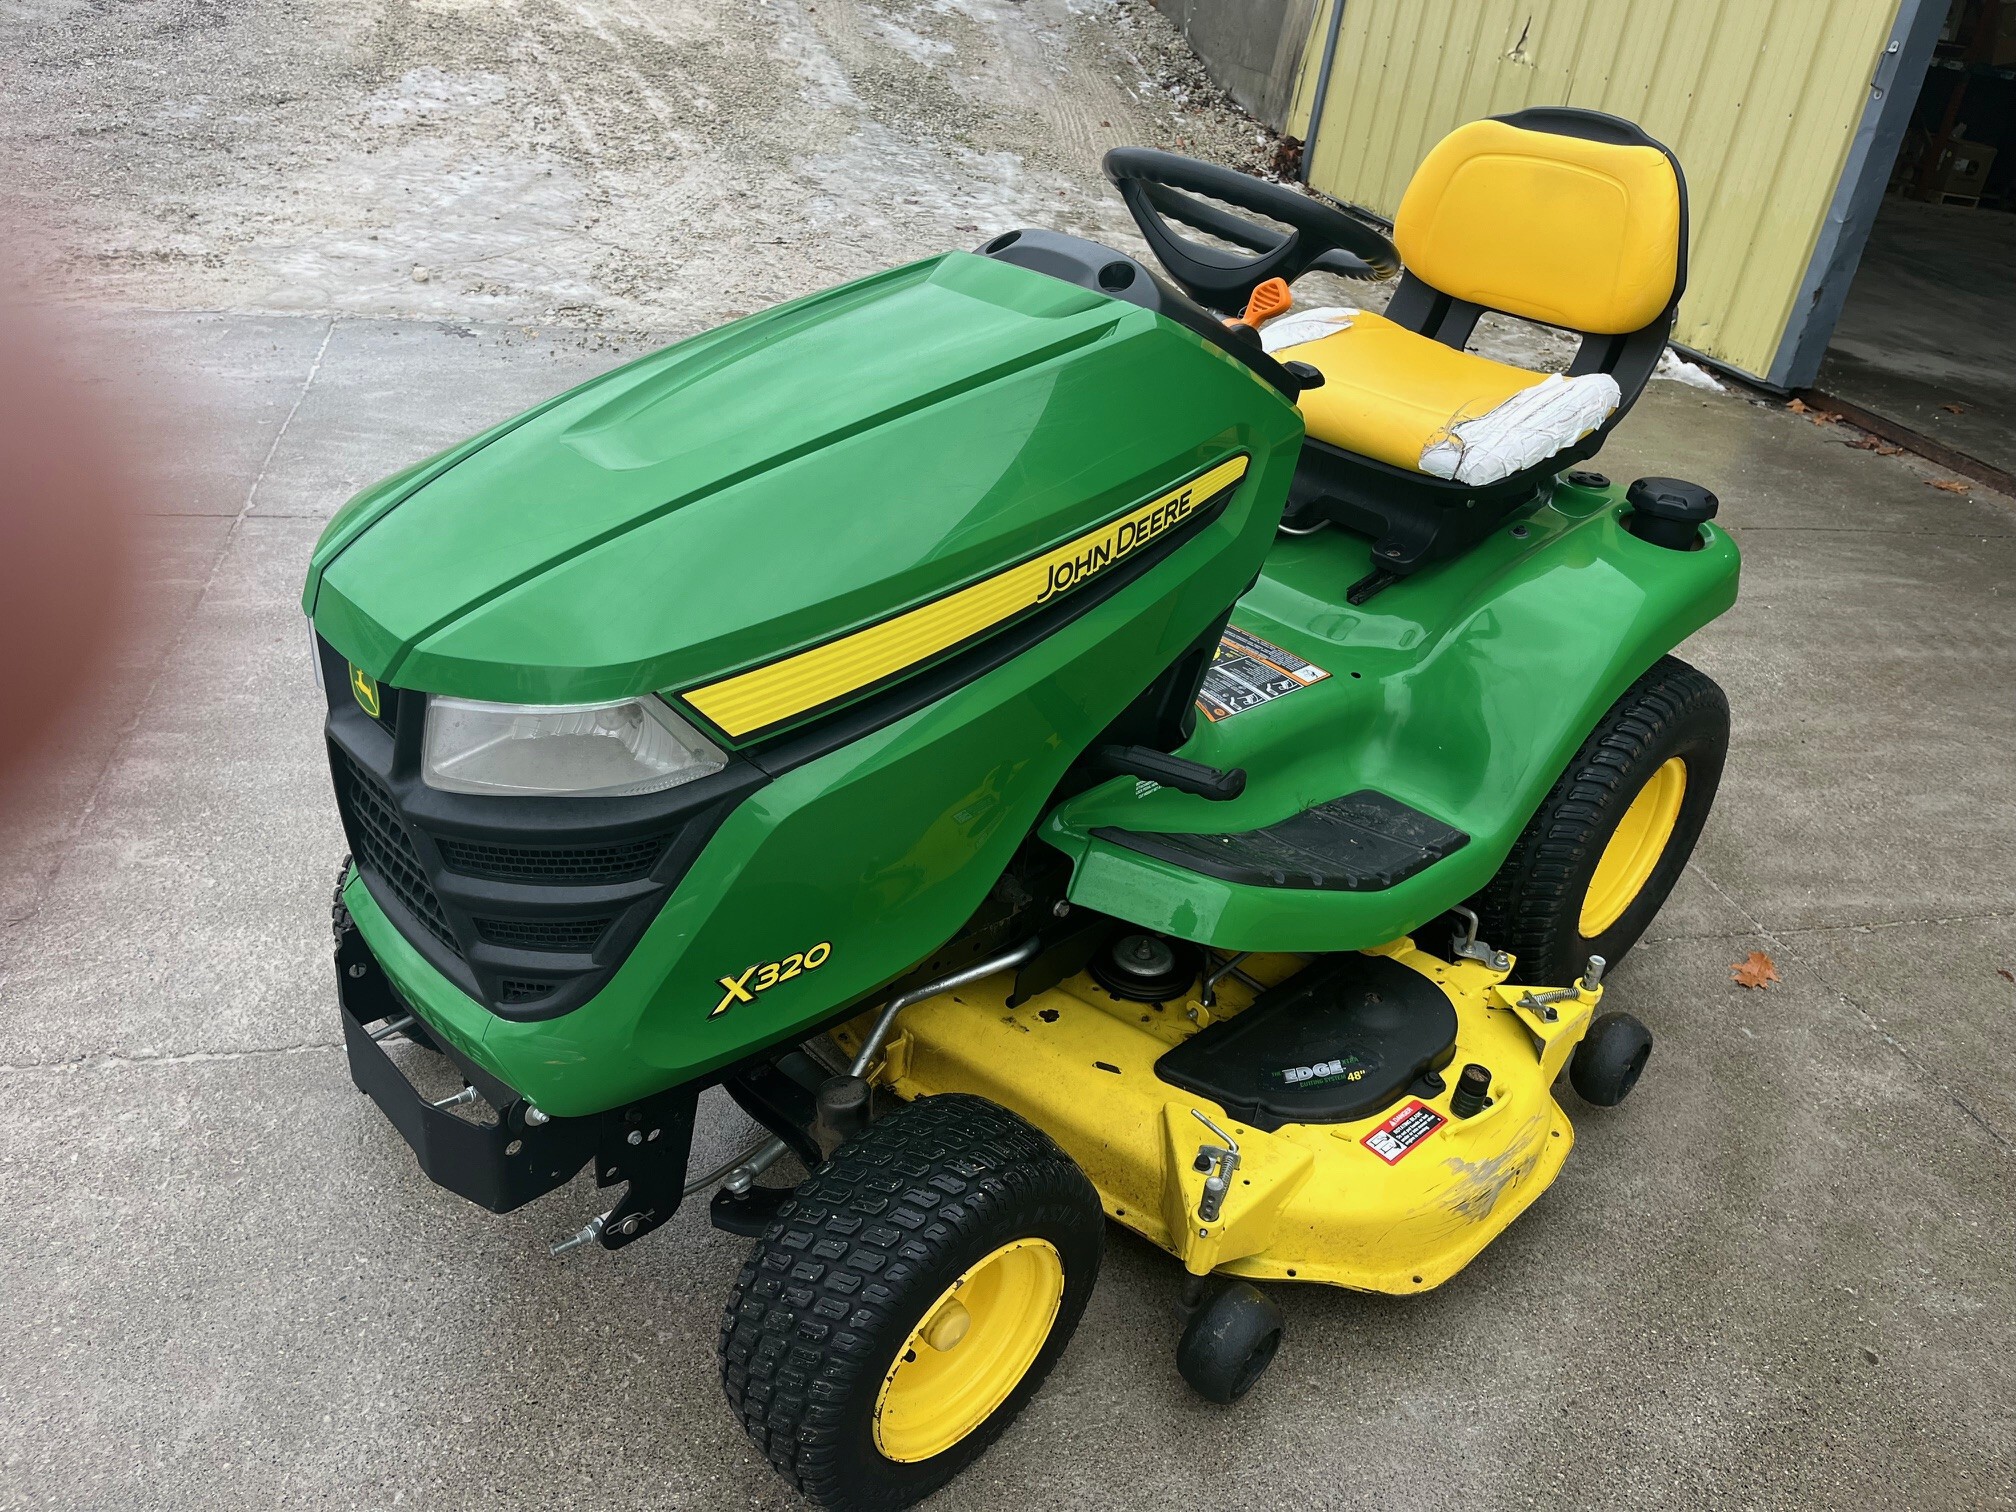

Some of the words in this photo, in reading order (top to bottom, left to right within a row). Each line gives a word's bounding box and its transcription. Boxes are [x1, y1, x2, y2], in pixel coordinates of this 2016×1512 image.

[1037, 538, 1111, 603] JOHN
[1116, 488, 1193, 558] DEERE
[709, 941, 832, 1018] X320
[1282, 1060, 1344, 1084] EDGE
[1324, 1074, 1346, 1084] SYSTEM
[1347, 1069, 1366, 1082] 48"
[1392, 1106, 1414, 1122] DANGER
